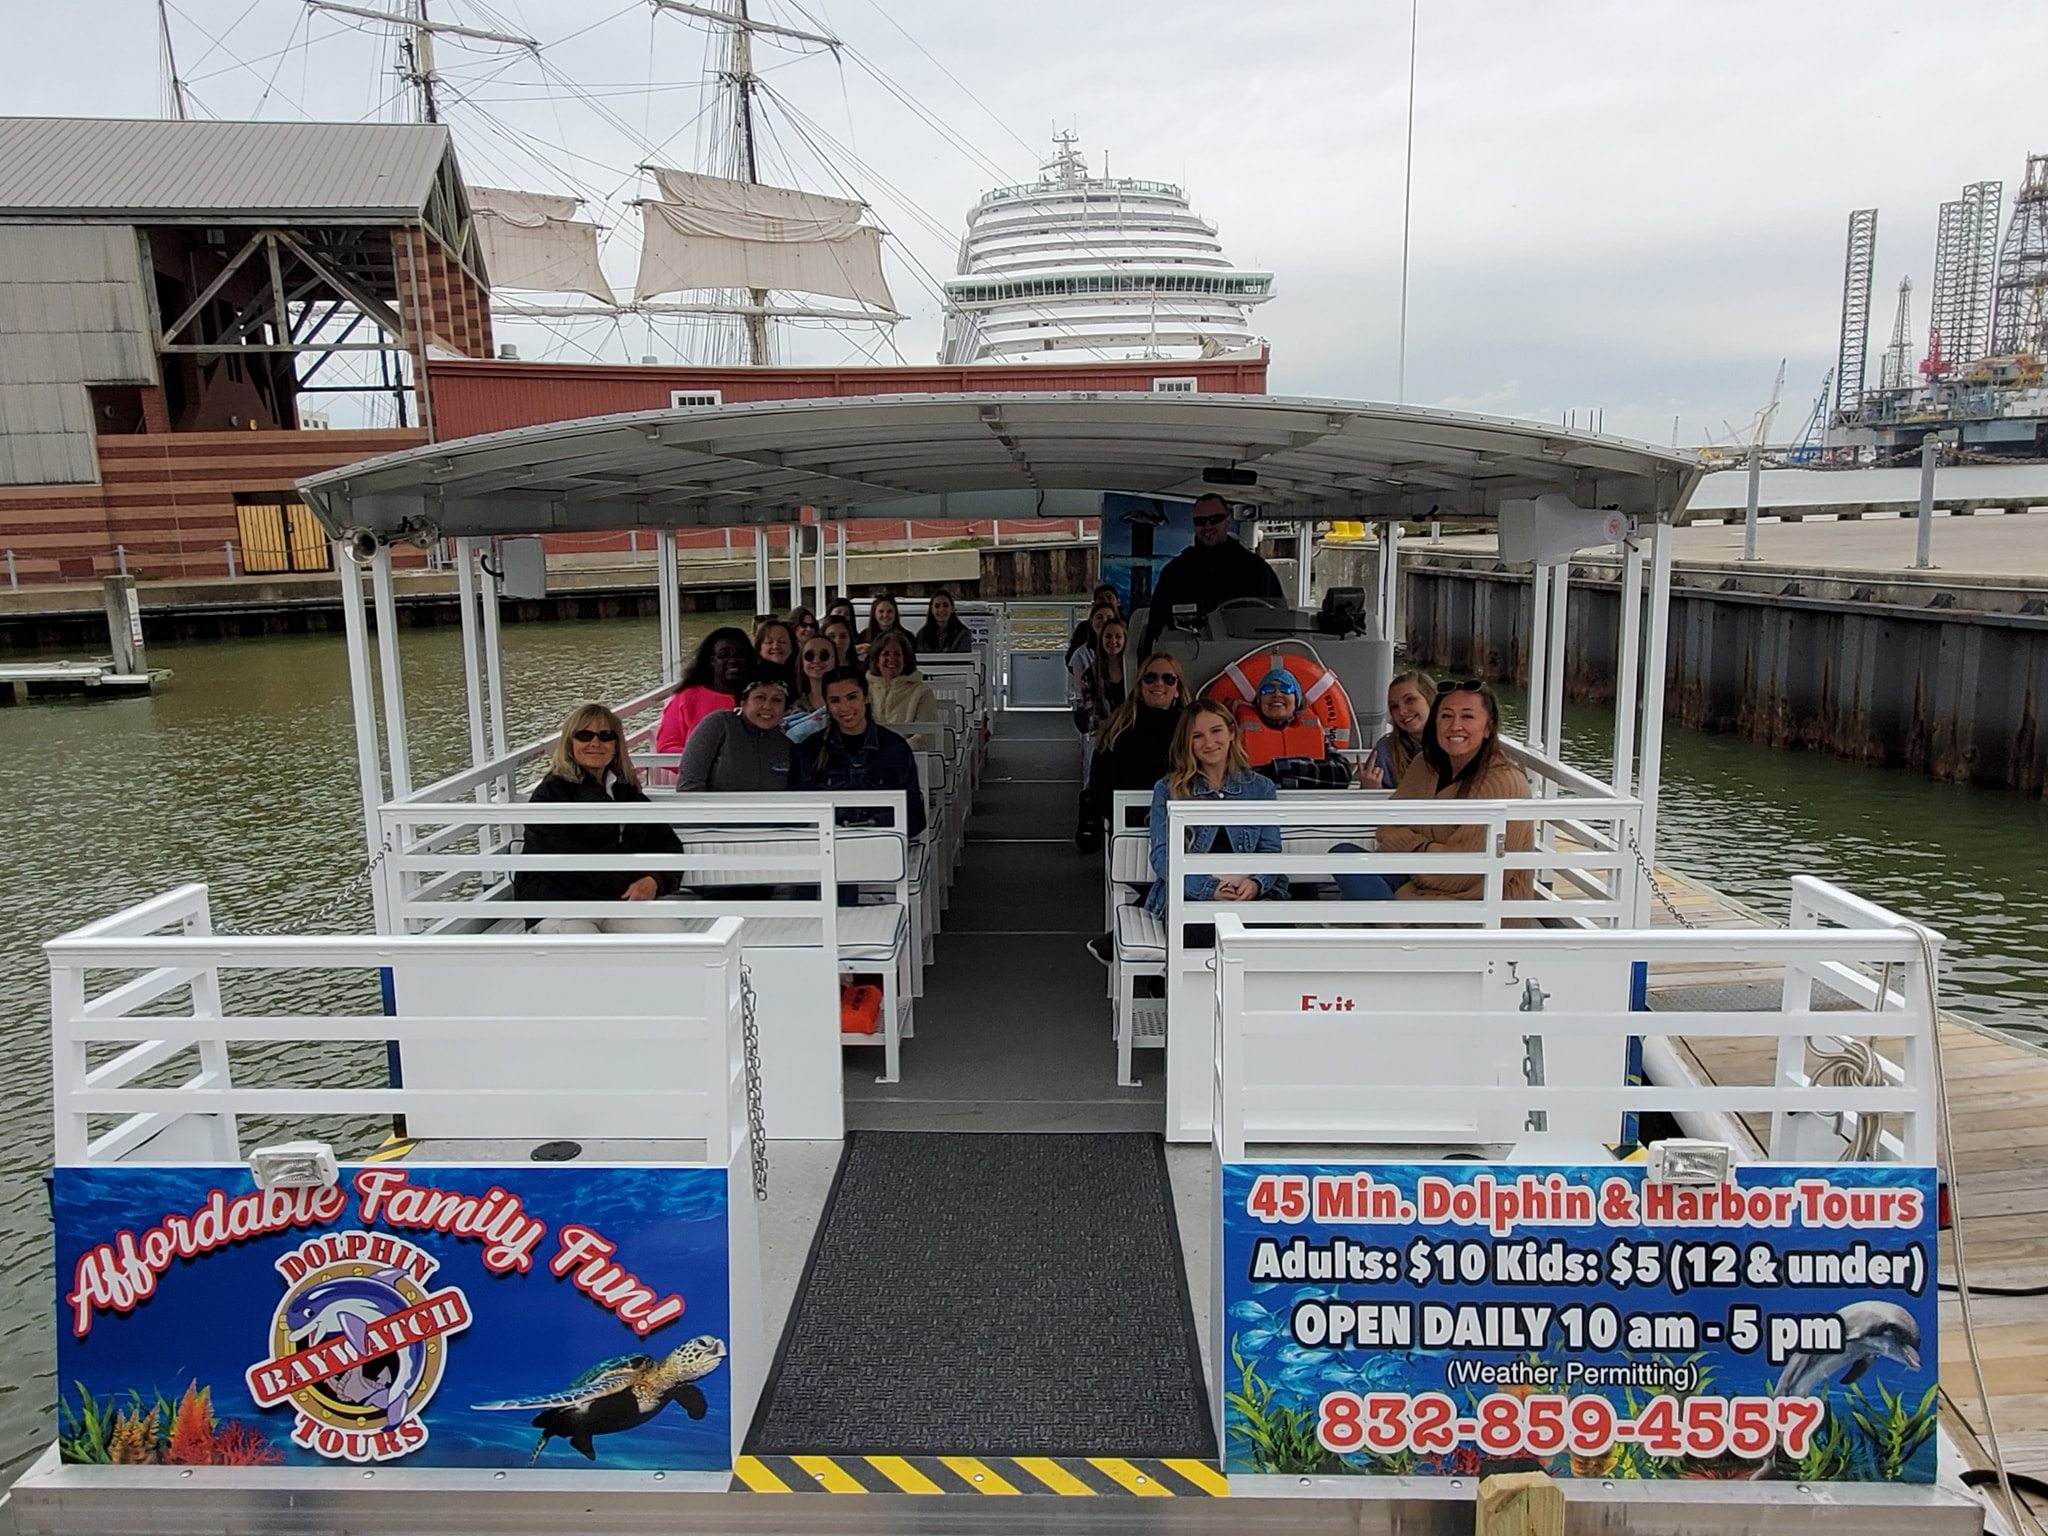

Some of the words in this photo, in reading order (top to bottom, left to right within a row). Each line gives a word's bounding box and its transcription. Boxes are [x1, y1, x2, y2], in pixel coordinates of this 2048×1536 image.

[1323, 694, 1337, 723] Texas
[1251, 1180, 1306, 1221] 45
[1318, 1178, 1411, 1222] Min.
[1424, 1178, 1591, 1231] Dolphin
[1603, 1182, 1634, 1221] &
[1646, 1182, 1793, 1222] Harbor
[1800, 1184, 1918, 1223] Tours
[70, 1186, 346, 1334] Affordable
[357, 1171, 544, 1270] Family
[553, 1228, 682, 1331] Fun!
[279, 1234, 435, 1283] DOLPHIN
[1253, 1240, 1398, 1280] Adults:
[1410, 1240, 1487, 1285] $10
[1500, 1243, 1598, 1283] Kids:
[1610, 1242, 1661, 1286] $5
[1669, 1244, 1738, 1290] (12
[1747, 1246, 1778, 1284] &
[1788, 1246, 1924, 1292] under)
[259, 1298, 462, 1396] BAYWATCH
[1294, 1303, 1412, 1346] OPEN
[1423, 1306, 1552, 1347] DAILY
[1560, 1307, 1617, 1348] 10
[1627, 1315, 1696, 1349] am
[1706, 1326, 1721, 1338] -
[1731, 1309, 1759, 1350] 5
[1770, 1313, 1842, 1362] pm
[1447, 1360, 1559, 1389] (Weather
[1567, 1361, 1698, 1390] Permitting)
[296, 1413, 424, 1458] TOURS
[1321, 1396, 1819, 1452] 832-859-4557
